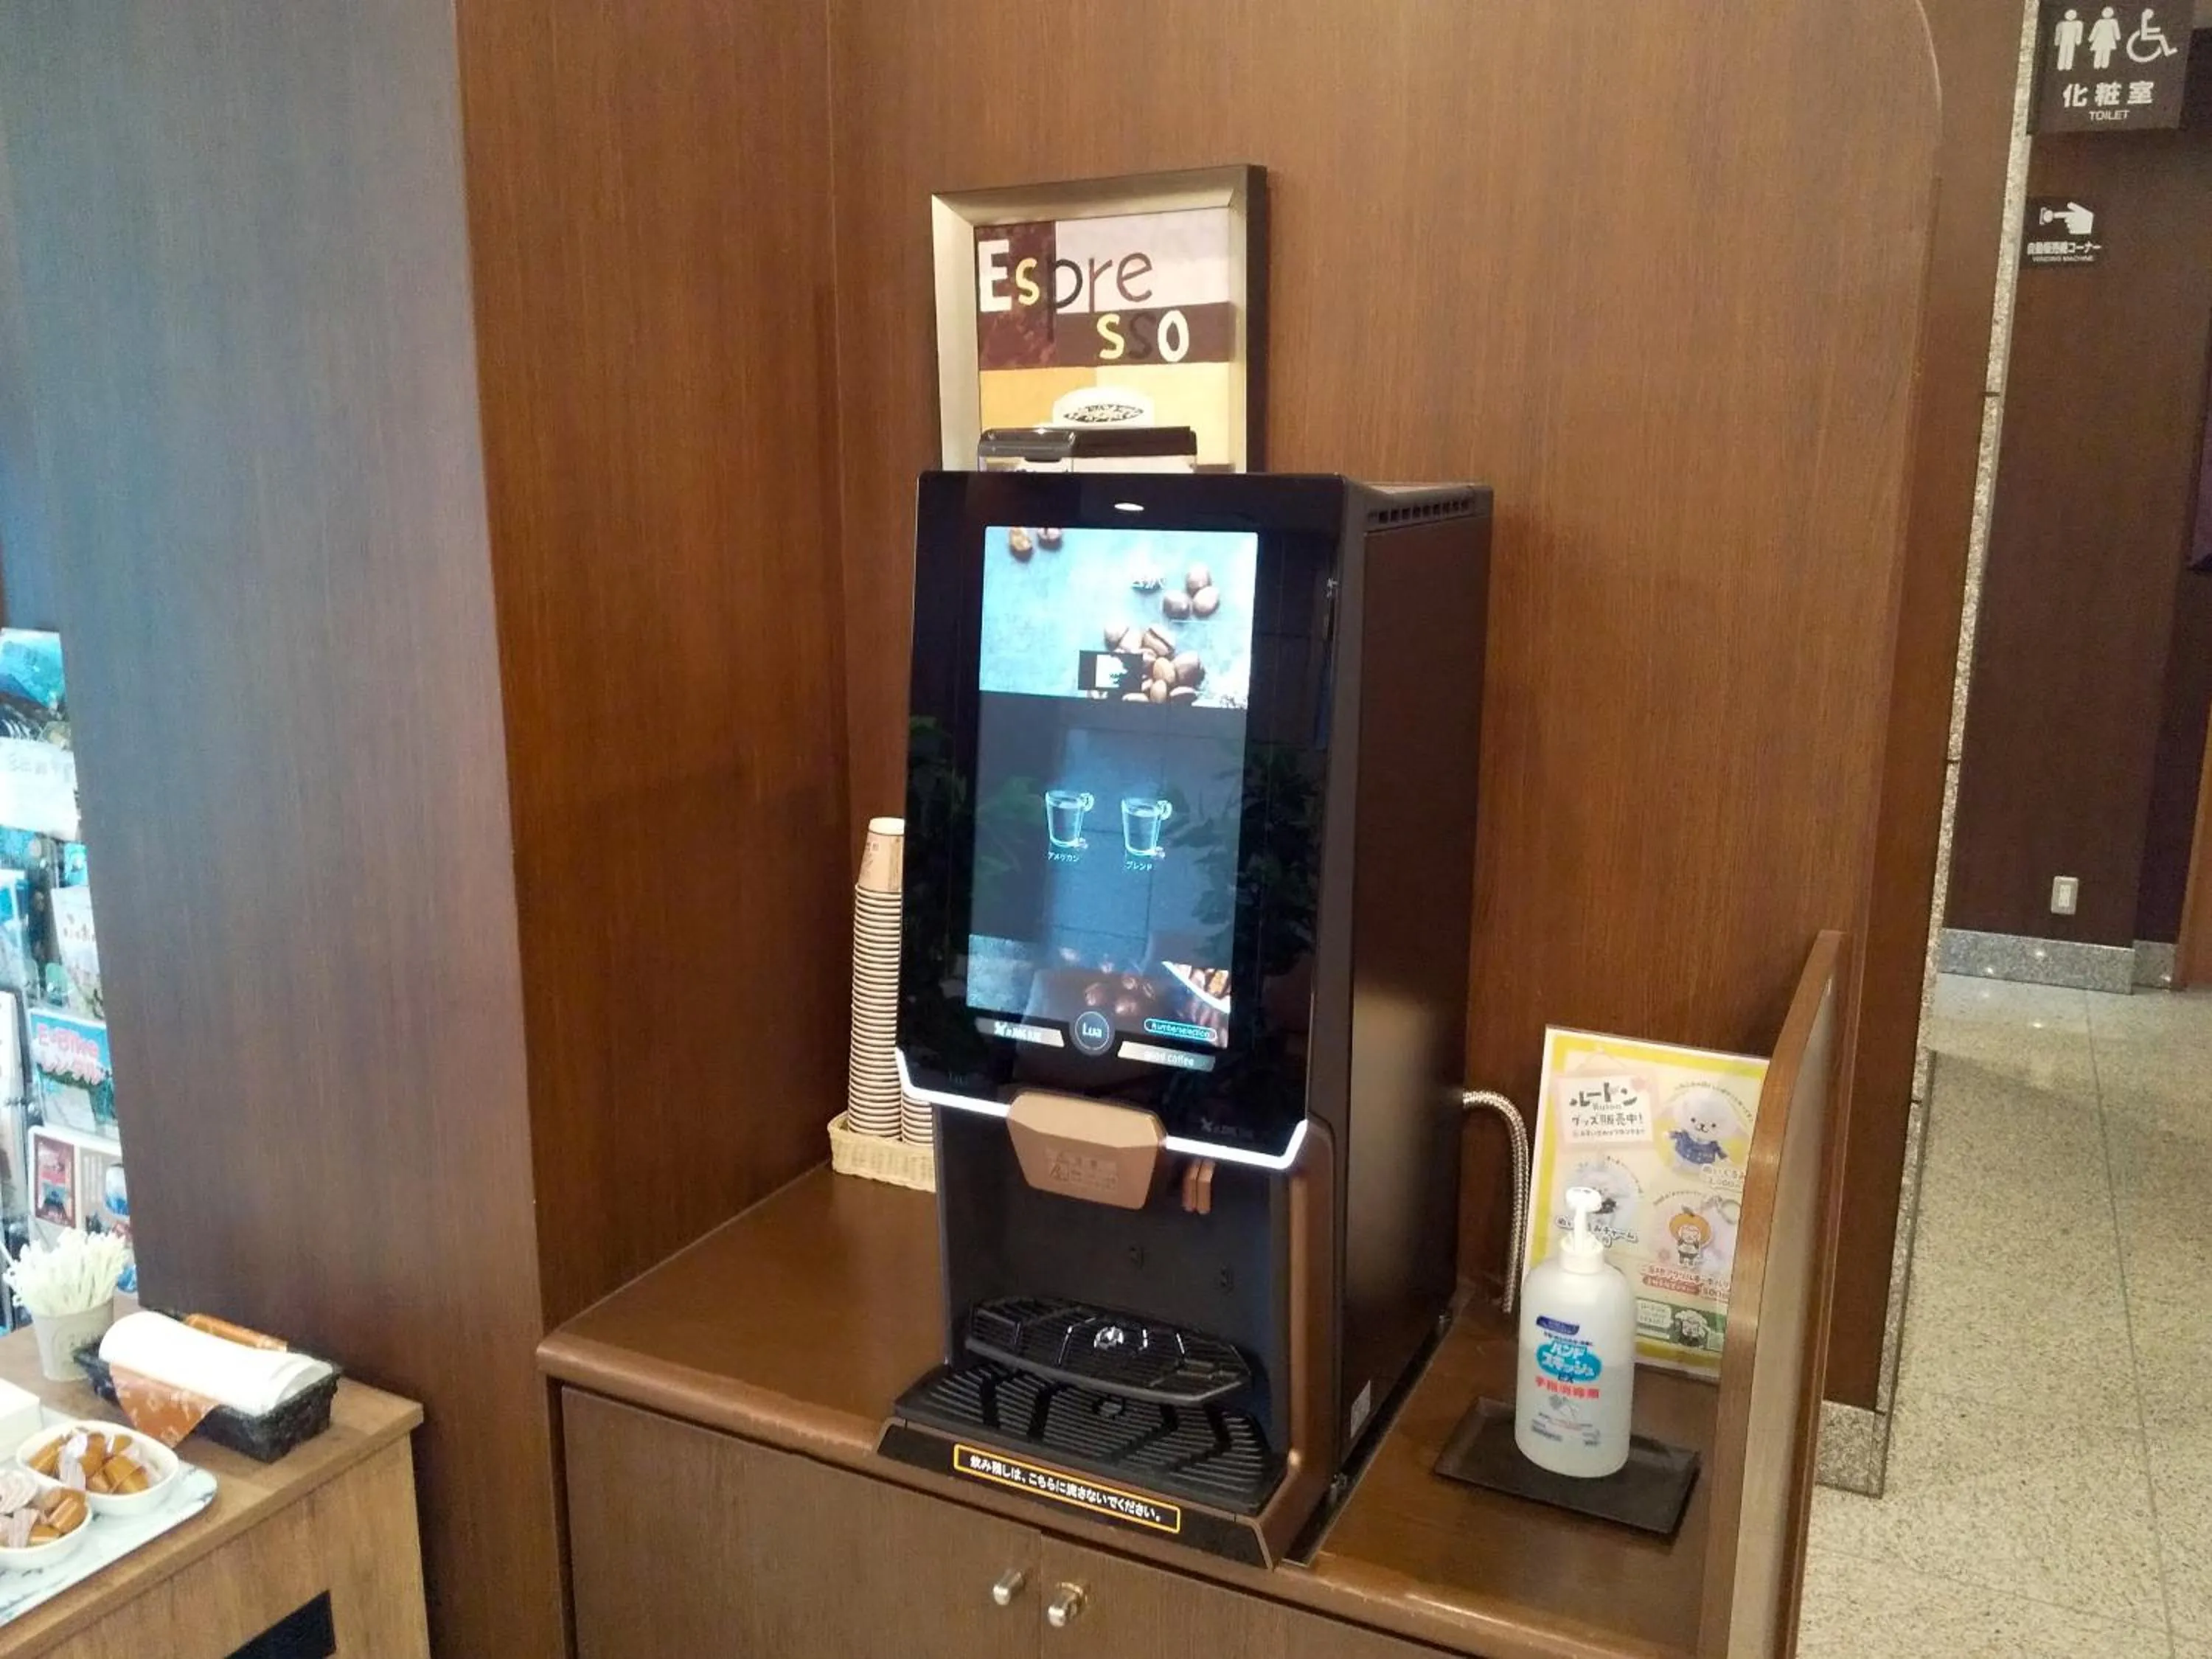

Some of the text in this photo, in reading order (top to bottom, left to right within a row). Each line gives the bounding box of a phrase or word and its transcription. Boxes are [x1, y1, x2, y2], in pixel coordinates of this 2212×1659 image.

[2062, 80, 2154, 108] 化粧室
[2089, 110, 2130, 121] TOILET
[1047, 852, 1154, 871] アメリカン ブレンド
[1082, 1022, 1103, 1038] Lua
